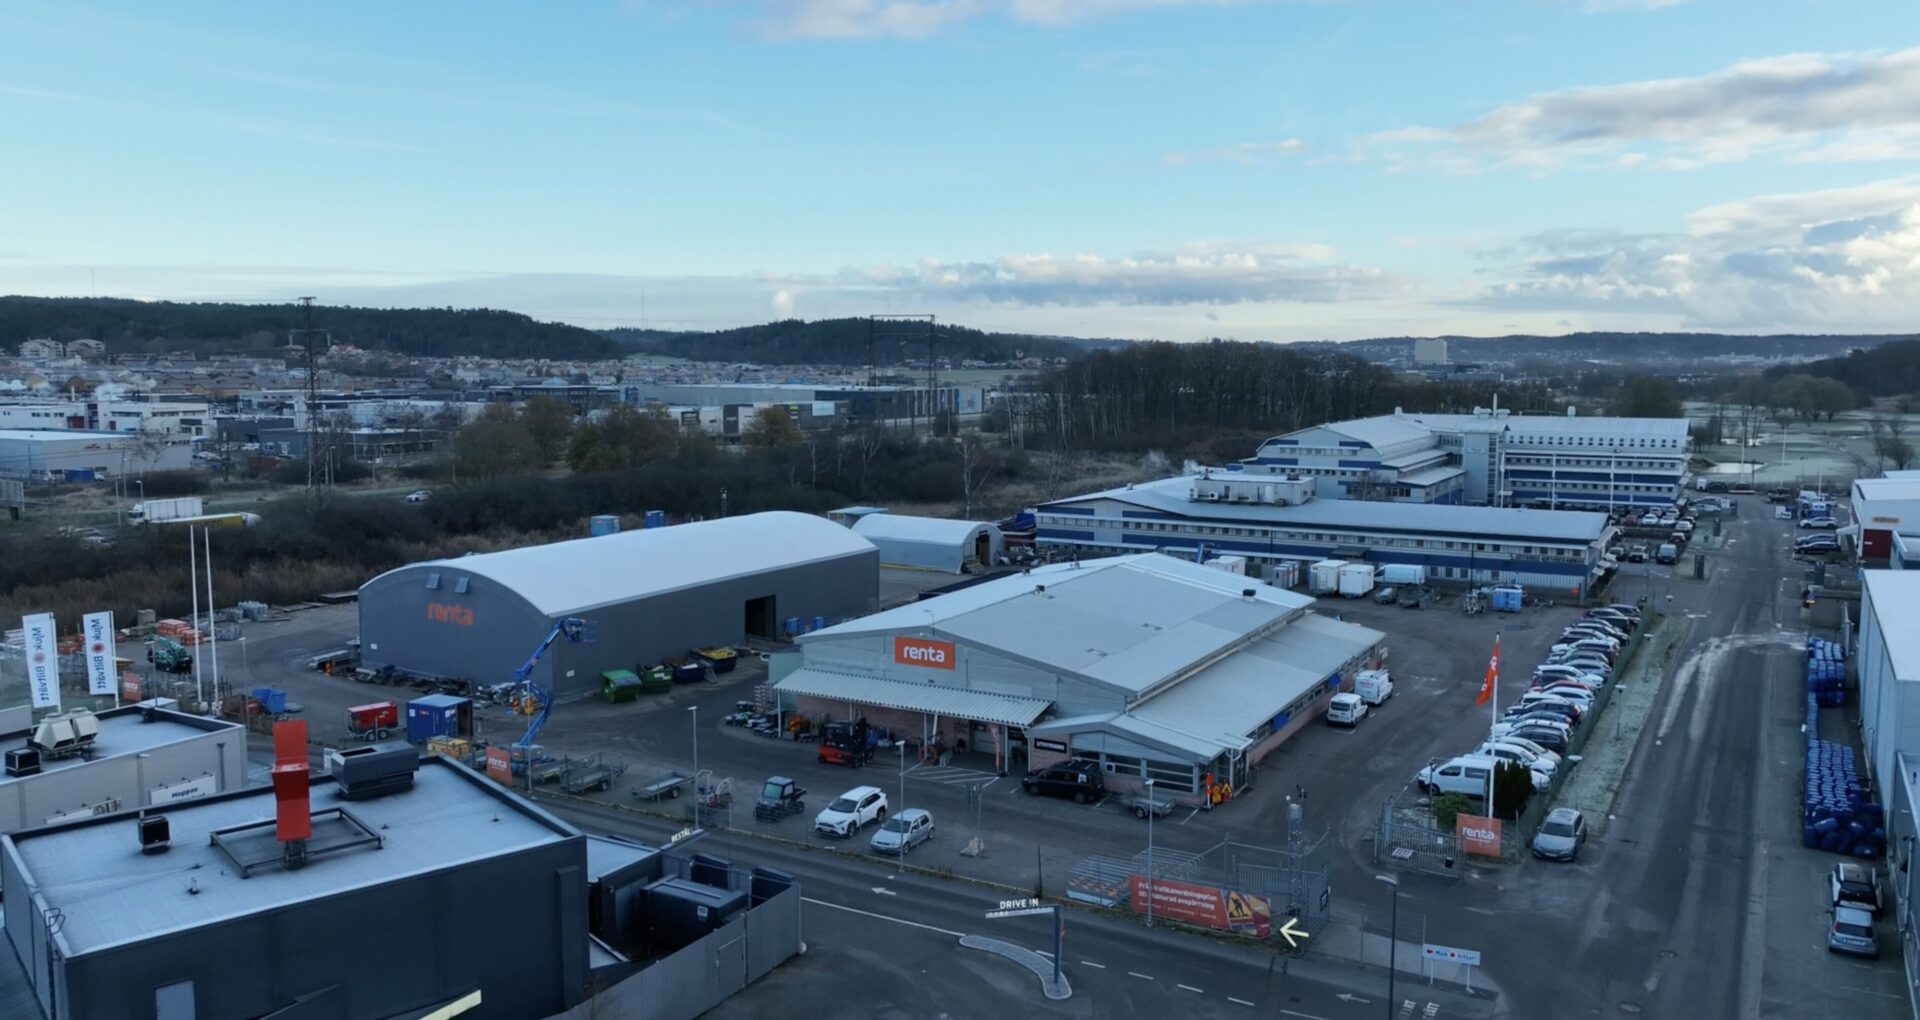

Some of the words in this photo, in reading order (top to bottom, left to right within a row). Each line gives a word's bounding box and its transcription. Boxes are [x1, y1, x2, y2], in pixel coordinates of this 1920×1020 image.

[427, 603, 473, 625] renta
[903, 645, 945, 663] renta
[1462, 826, 1495, 840] renta
[999, 899, 1027, 910] DRIVE
[1029, 897, 1039, 906] IN
